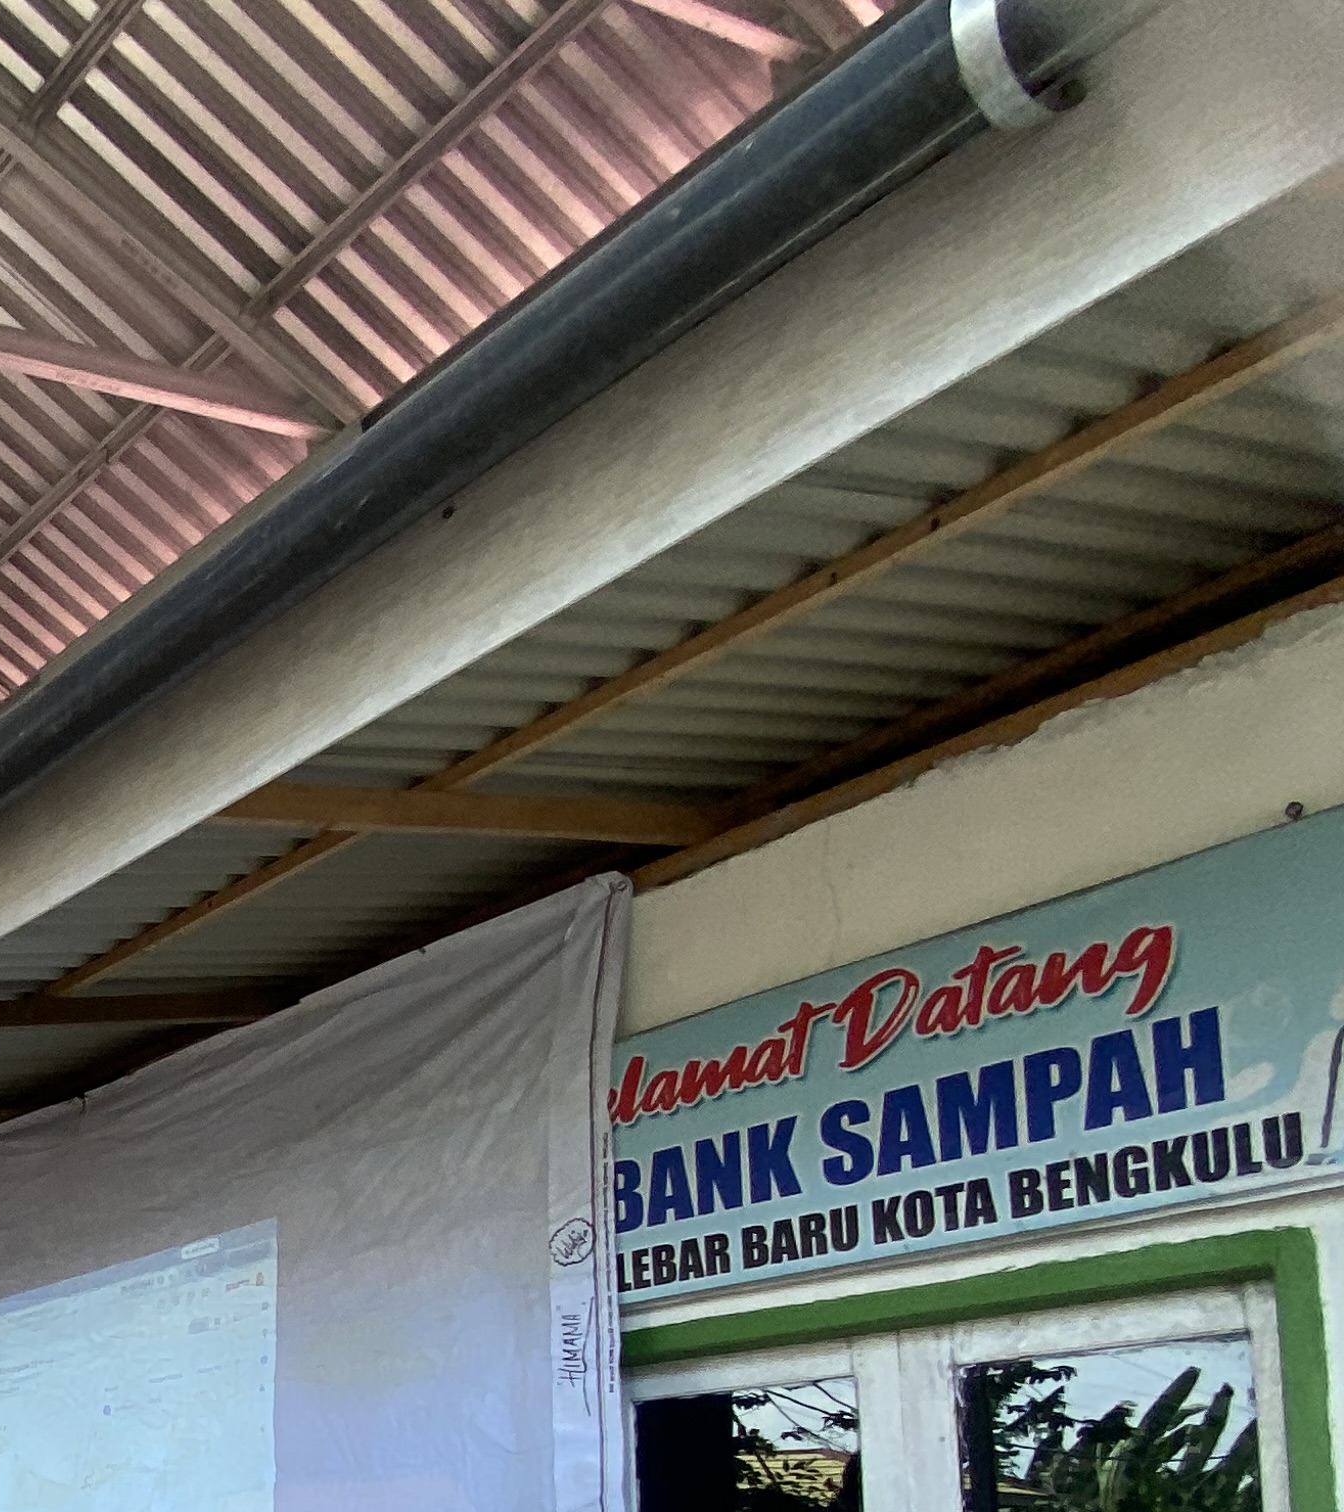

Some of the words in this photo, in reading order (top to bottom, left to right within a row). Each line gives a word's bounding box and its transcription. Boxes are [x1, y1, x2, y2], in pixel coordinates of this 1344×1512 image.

[831, 925, 1174, 1069] Datang
[614, 1115, 803, 1235] BANK
[820, 1006, 1225, 1187] SAMPAH
[616, 1233, 731, 1293] LEBAR
[740, 1204, 860, 1270] BARU
[873, 1178, 999, 1245] KOTA
[1008, 1111, 1304, 1220] BENGKULU
